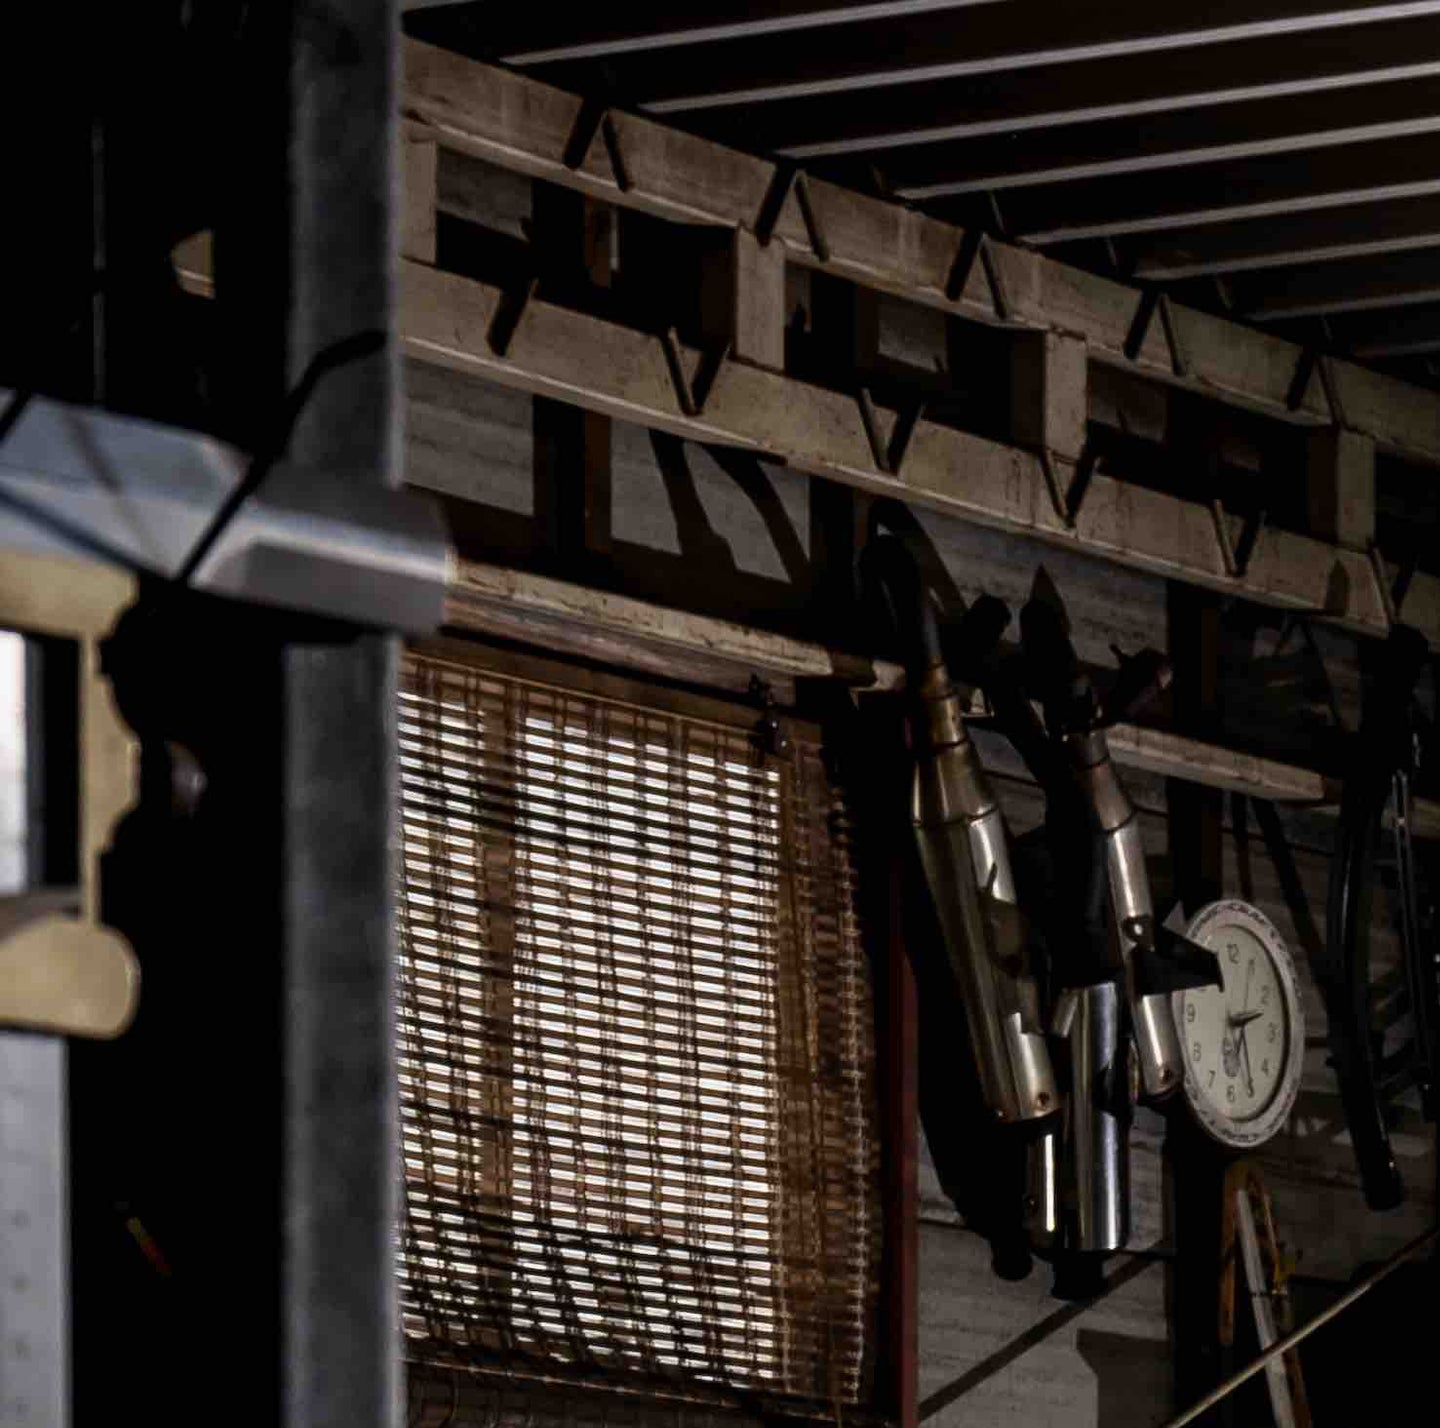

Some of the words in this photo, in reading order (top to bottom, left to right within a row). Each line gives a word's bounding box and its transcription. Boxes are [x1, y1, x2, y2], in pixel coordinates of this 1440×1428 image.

[1226, 943, 1240, 964] 12
[1185, 1003, 1196, 1023] 9
[1261, 1057, 1270, 1077] 4
[1207, 1070, 1217, 1089] 7
